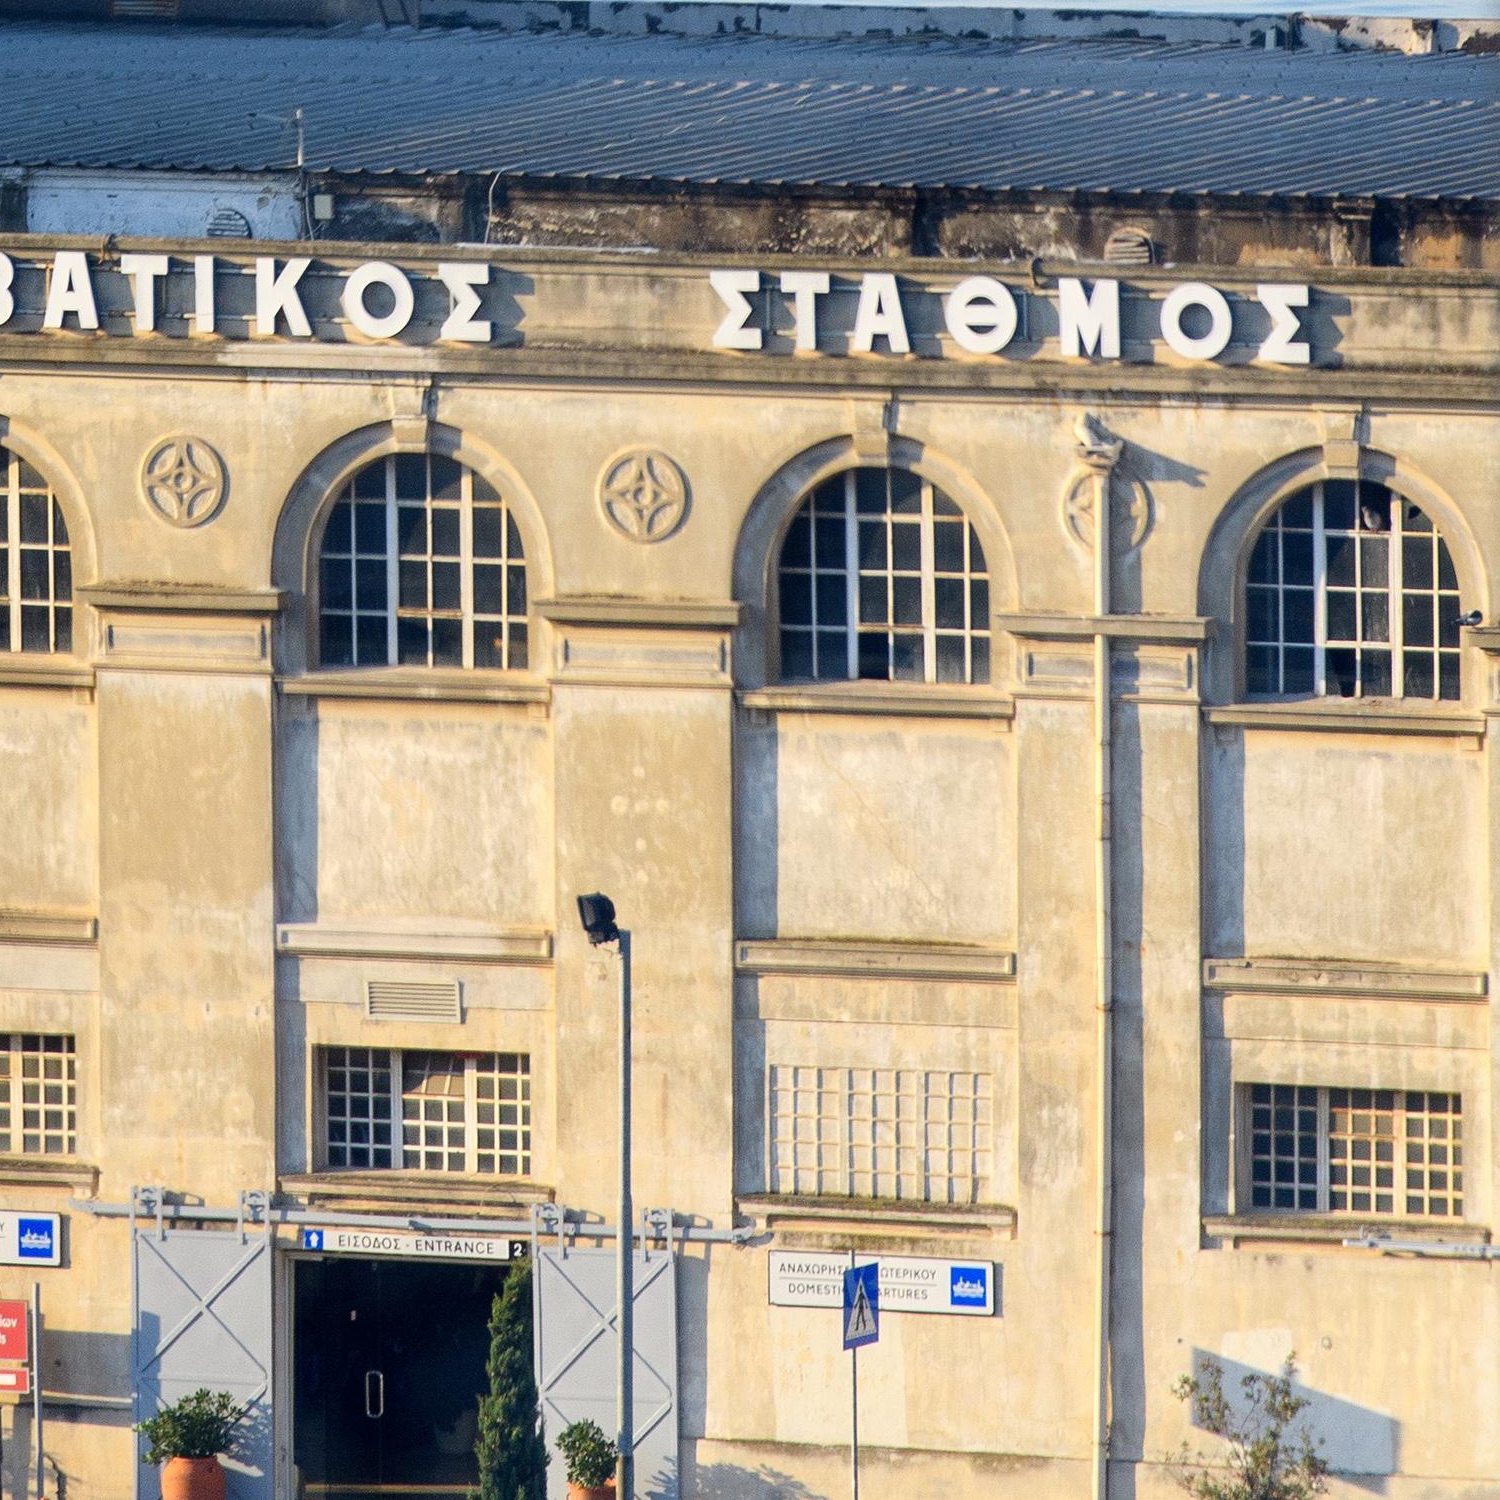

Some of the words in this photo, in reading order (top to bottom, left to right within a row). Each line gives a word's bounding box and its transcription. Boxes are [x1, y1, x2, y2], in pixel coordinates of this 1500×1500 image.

[709, 269, 1310, 365] ΣΤΑΘΜΟΣ
[338, 1234, 401, 1250] ΕΙΣΟΔΟΣ
[415, 1239, 495, 1255] ENTRANCE
[513, 1242, 524, 1258] 2
[788, 1282, 842, 1297] DOMESTI
